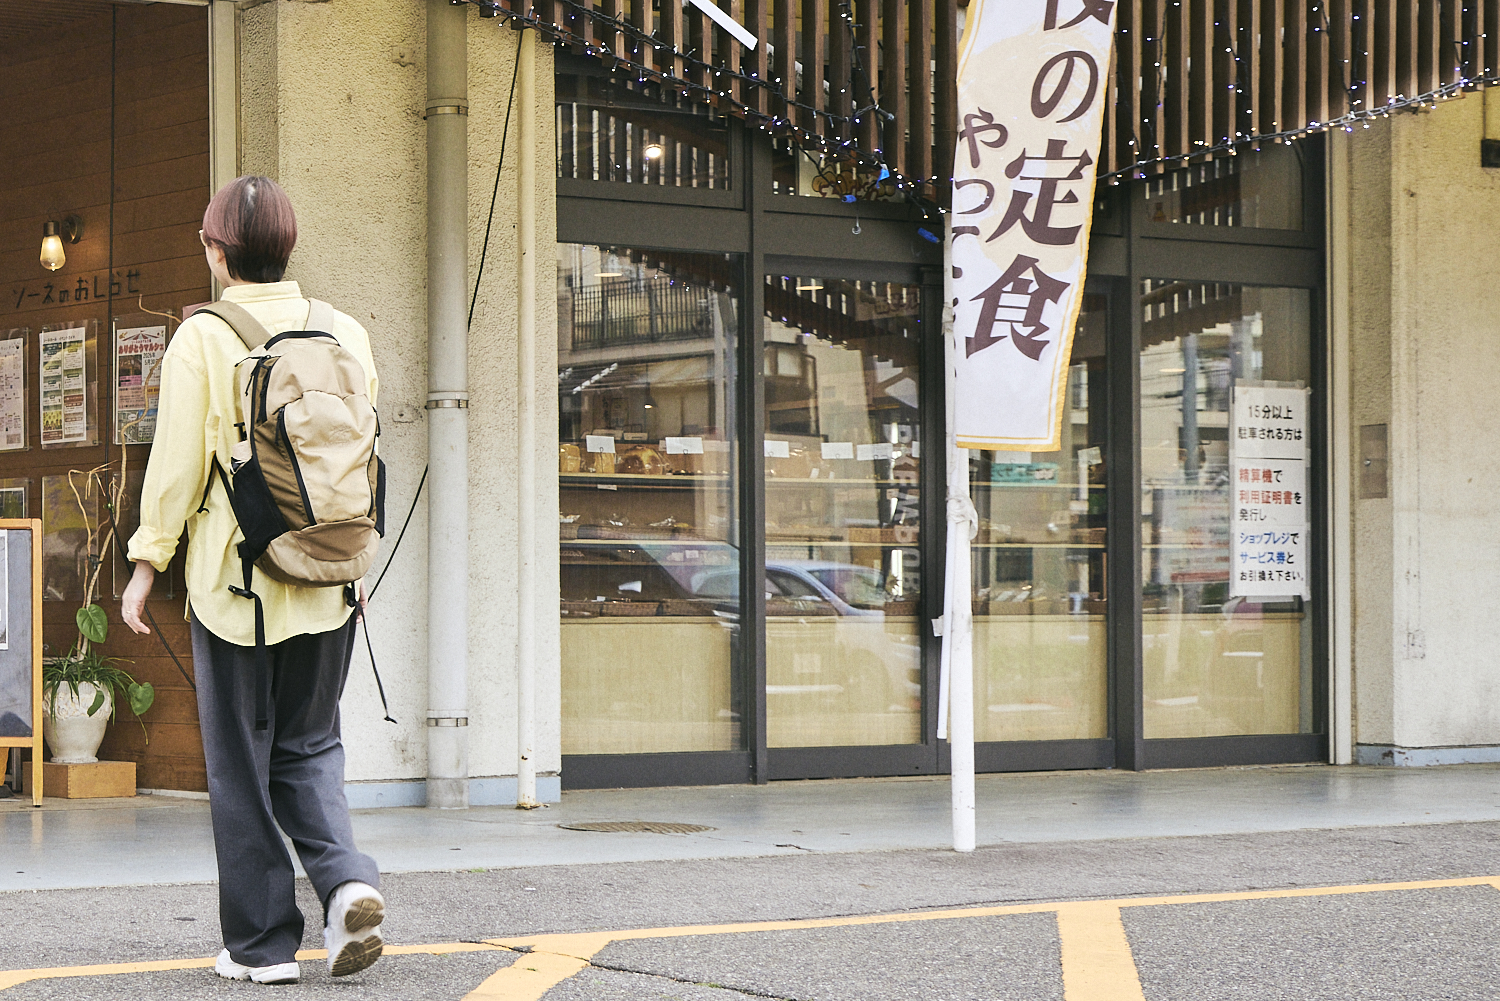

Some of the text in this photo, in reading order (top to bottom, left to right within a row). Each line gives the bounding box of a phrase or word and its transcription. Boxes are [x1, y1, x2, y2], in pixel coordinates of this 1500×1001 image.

[13, 269, 140, 309] ソーネのおしらせ
[1248, 405, 1293, 420] 15分以上
[1238, 426, 1303, 441] 駐車される方は
[1239, 468, 1283, 483] 精算機で
[1239, 490, 1302, 505] 利用証明書を
[1240, 532, 1299, 545] ショップレジで
[1240, 552, 1295, 564] サービス券と
